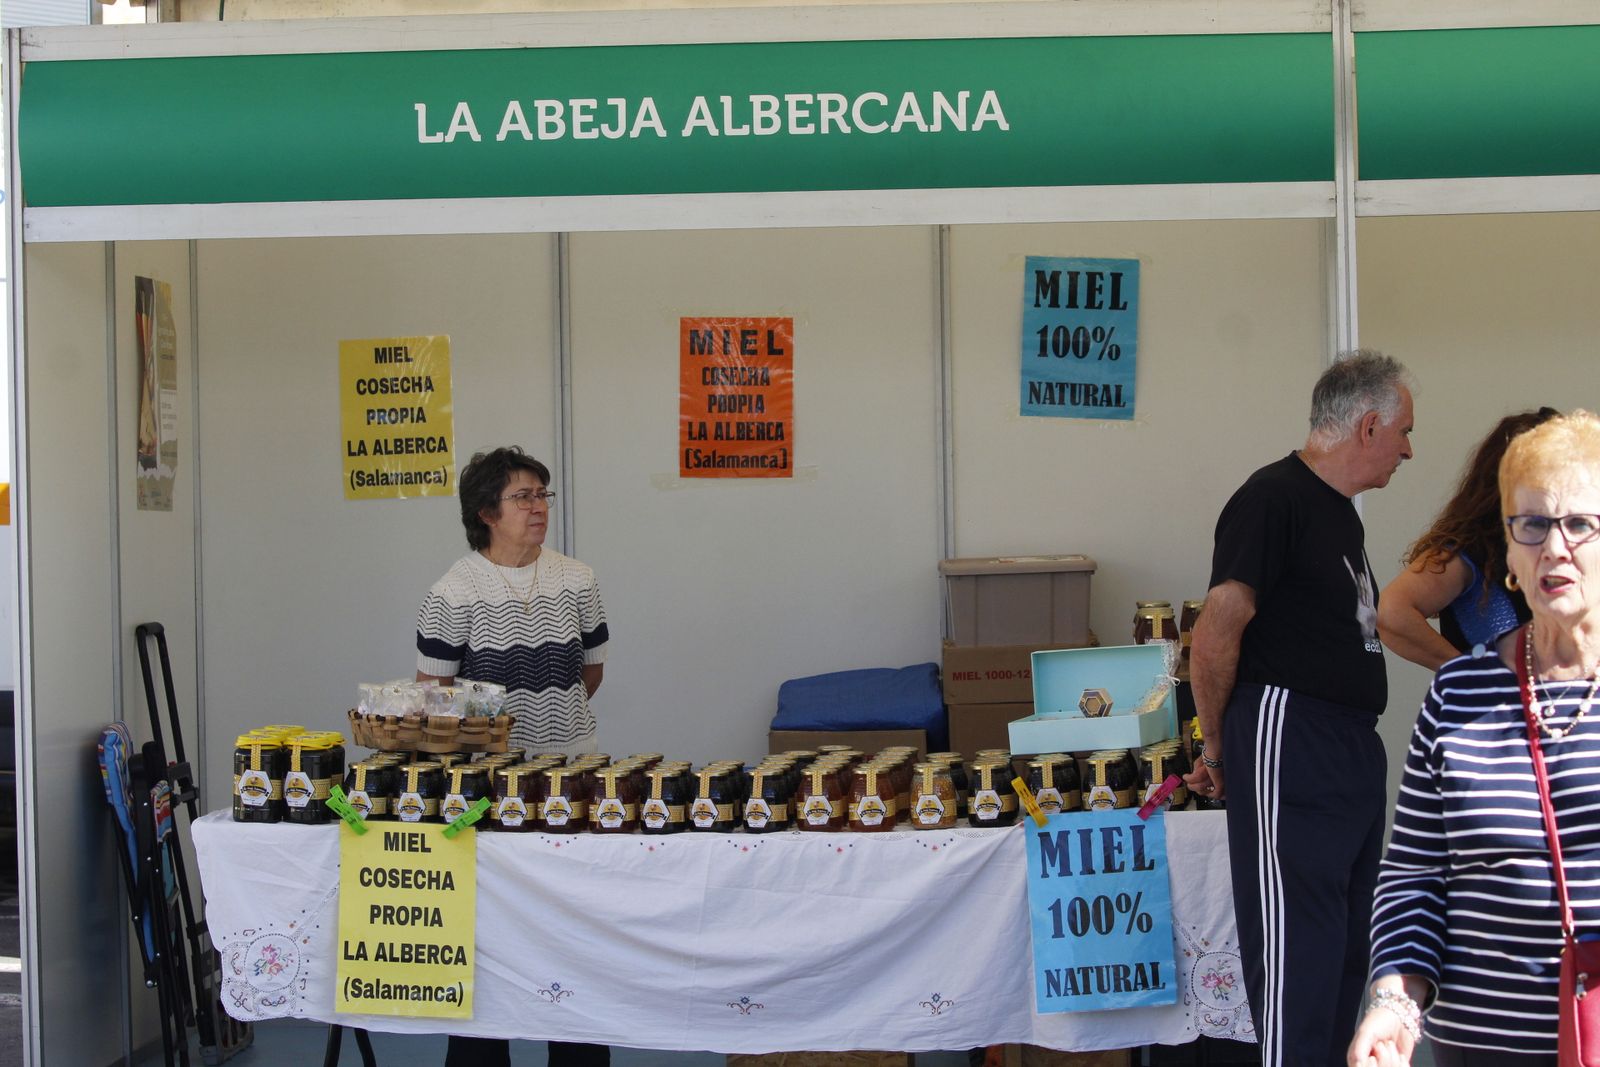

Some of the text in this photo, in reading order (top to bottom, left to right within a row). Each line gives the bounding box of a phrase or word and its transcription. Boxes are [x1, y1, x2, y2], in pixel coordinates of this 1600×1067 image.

[414, 90, 1010, 143] LA ABEJA ALBERCANA
[1034, 270, 1128, 311] MIEL
[374, 346, 414, 364] MIEL
[689, 329, 784, 356] MIEL
[1036, 324, 1121, 361] 100%
[356, 375, 435, 396] COSECHA
[701, 366, 771, 386] COSECHA
[707, 394, 765, 413] PROPIA
[1028, 381, 1126, 408] NATURAL
[366, 407, 427, 425] PROPIA
[688, 421, 785, 441] LA ALBERCA
[347, 436, 448, 457] LA ALBERCA
[350, 465, 448, 491] (Salamanca)
[952, 671, 981, 681] MIEL
[383, 831, 432, 853] MIEL
[1037, 825, 1155, 879] MIEL
[359, 867, 455, 891] COSECHA
[369, 904, 443, 928] PROPIA
[1047, 891, 1153, 939] 100%
[343, 940, 467, 966] LA ALBERCA
[344, 976, 464, 1007] (Salamanca)
[1044, 961, 1166, 998] NATURAL
